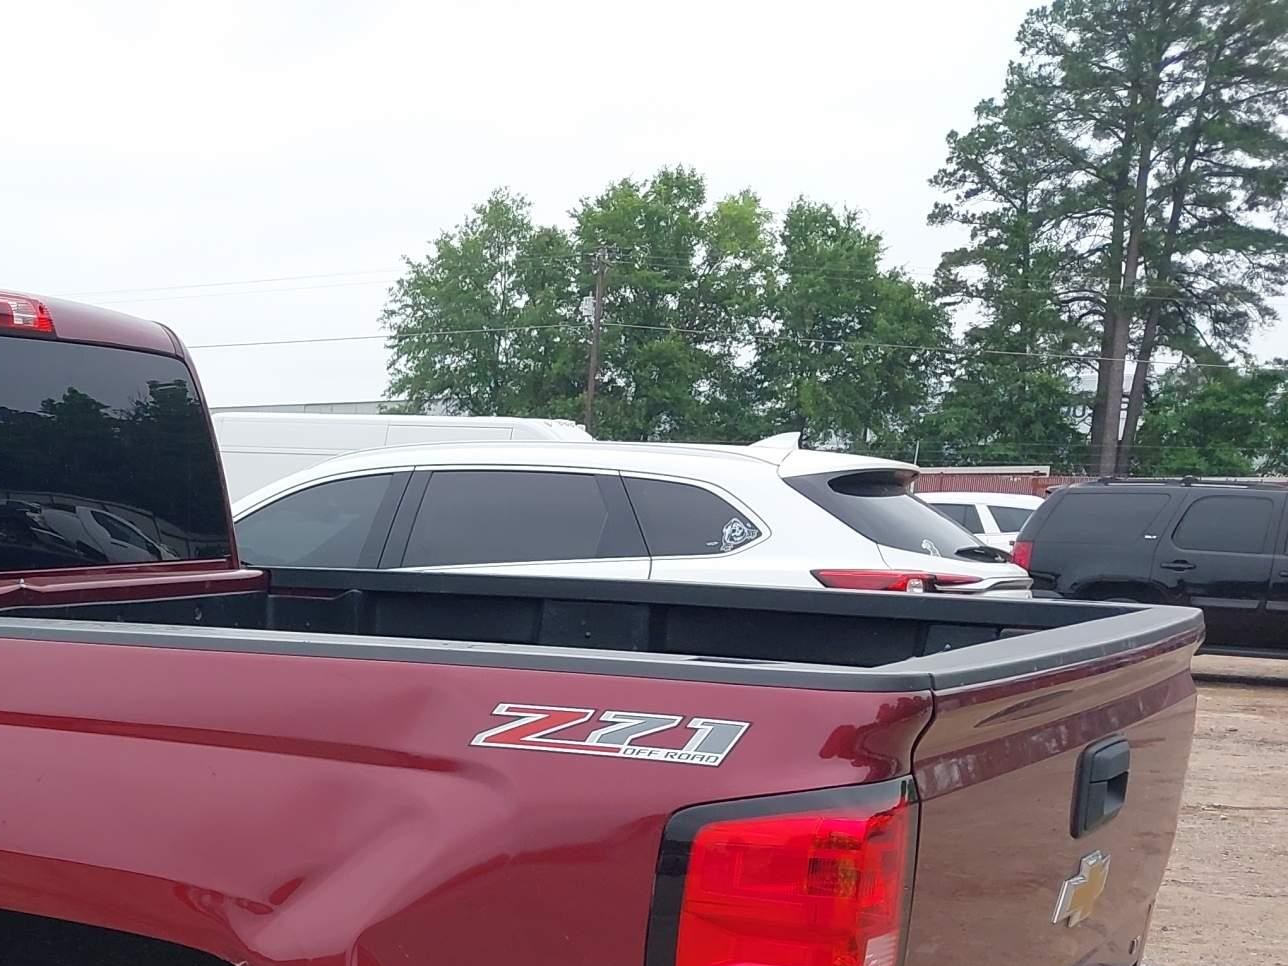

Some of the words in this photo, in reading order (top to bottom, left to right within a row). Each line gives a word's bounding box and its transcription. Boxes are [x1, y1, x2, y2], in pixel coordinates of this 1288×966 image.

[470, 702, 752, 764] Z71
[623, 747, 661, 757] OFF
[664, 751, 720, 764] ROAD
